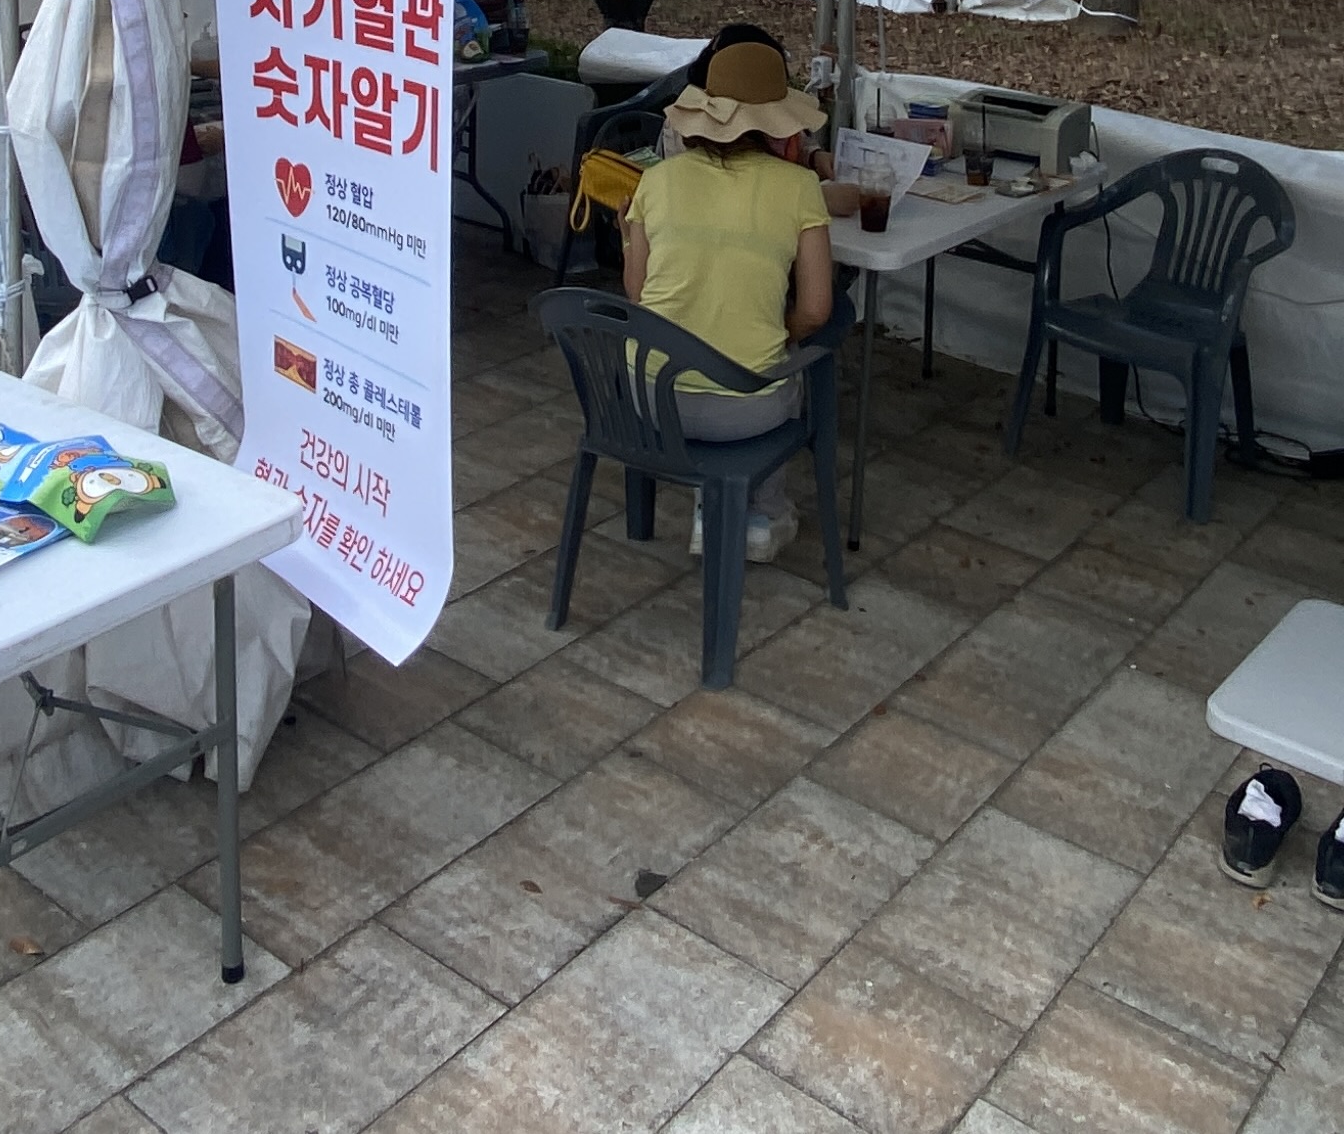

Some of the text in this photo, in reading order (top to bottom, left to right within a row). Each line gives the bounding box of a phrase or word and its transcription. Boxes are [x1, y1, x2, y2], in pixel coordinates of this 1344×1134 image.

[253, 46, 440, 174] 숫자알기
[325, 173, 374, 210] 정상 혈압
[326, 204, 427, 260] 120/80mmHg 미만
[325, 264, 395, 315] 정상 공복혈당
[379, 319, 399, 345] 미만
[323, 358, 346, 387] 정상
[363, 378, 423, 430] 콜레스테롤
[376, 416, 396, 443] 미만
[300, 427, 391, 518] 건강의 시작
[337, 524, 374, 573] 확인
[370, 546, 425, 608] 하세요
